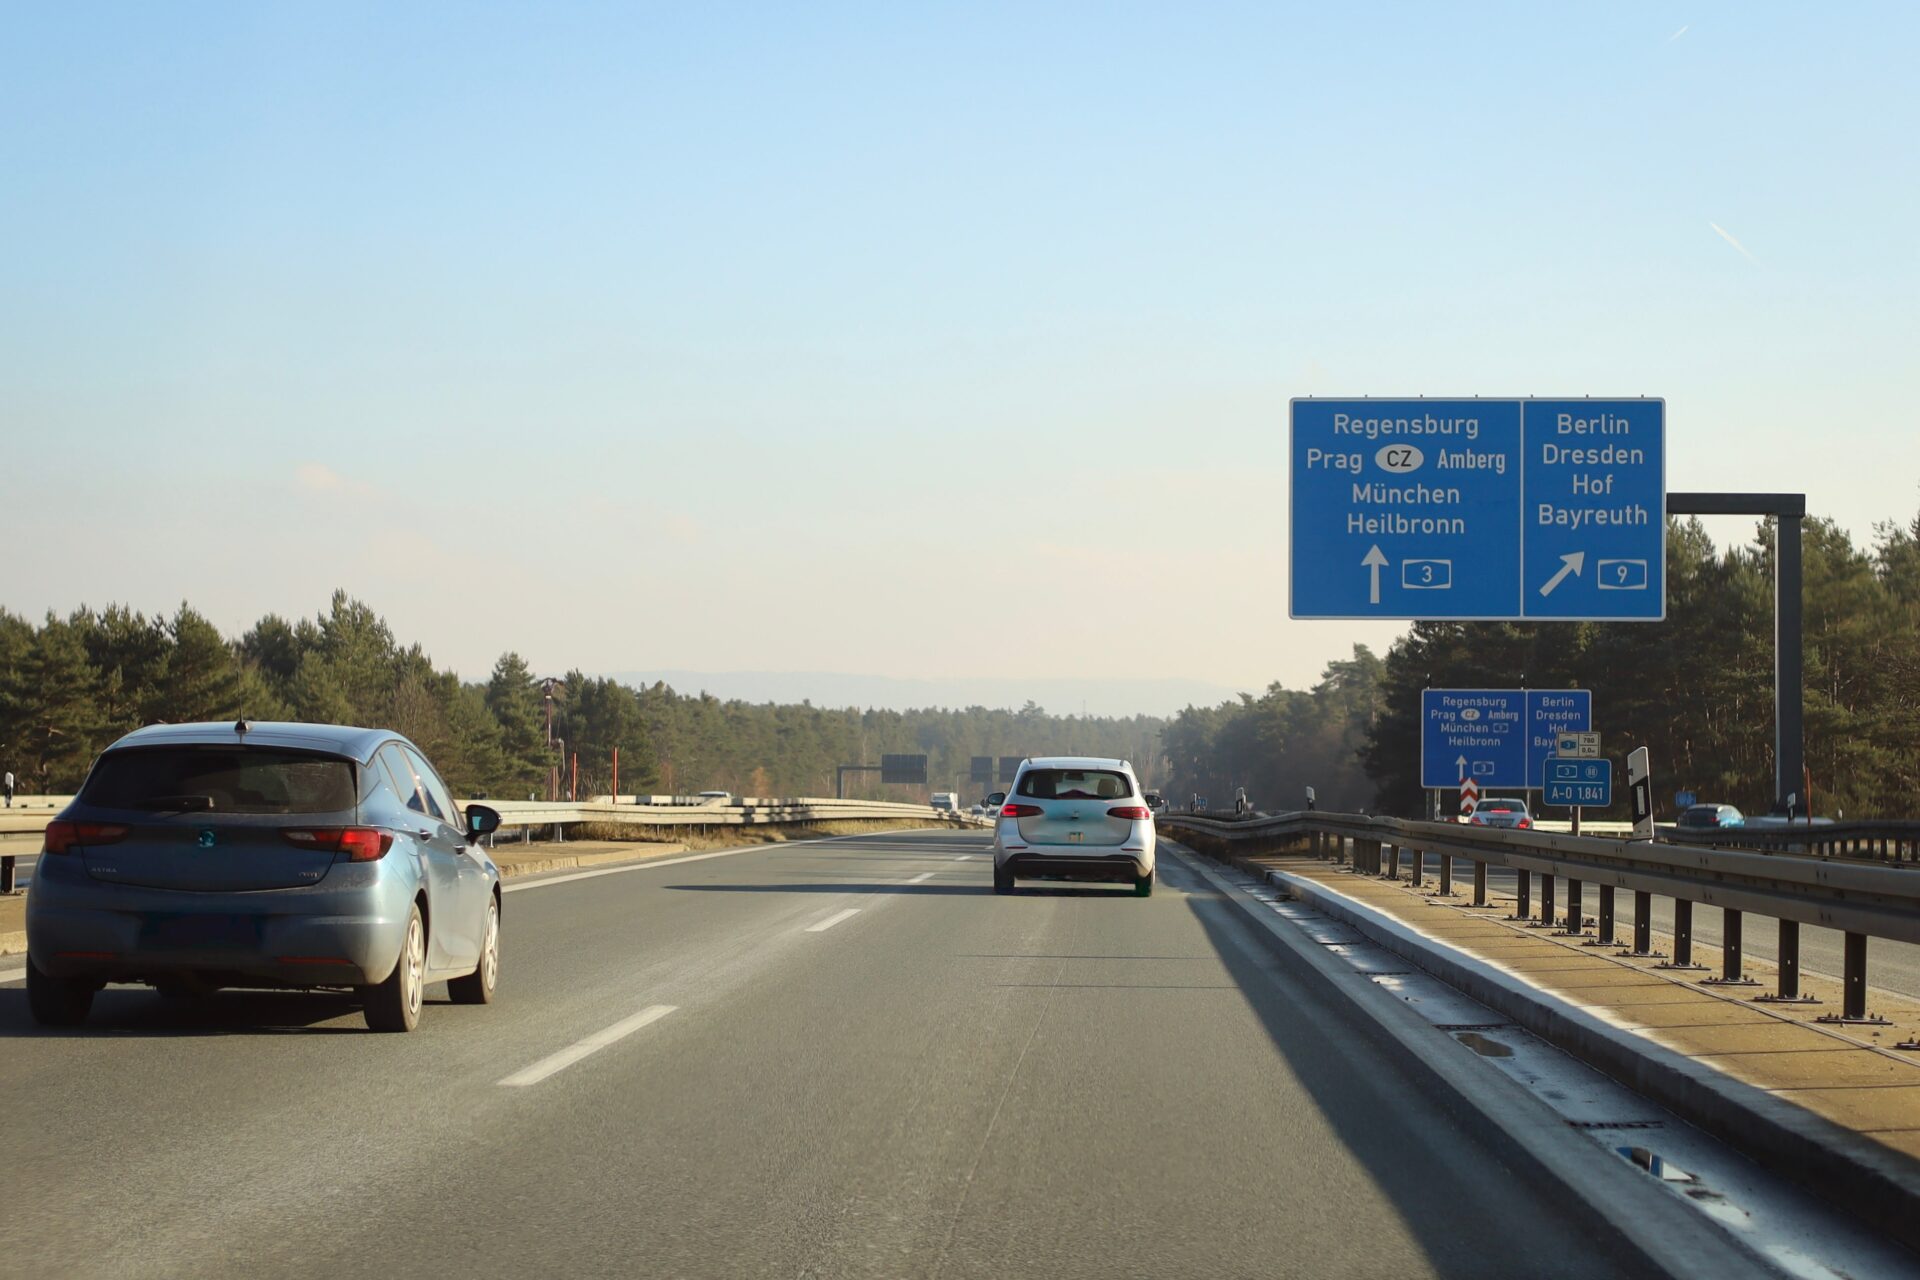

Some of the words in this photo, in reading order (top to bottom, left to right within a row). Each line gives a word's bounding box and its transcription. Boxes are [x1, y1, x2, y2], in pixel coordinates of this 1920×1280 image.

[1333, 414, 1479, 439] Regensburg
[1556, 414, 1629, 434] Berlin
[1307, 448, 1363, 474] Prag
[1386, 450, 1412, 467] CZ
[1437, 448, 1506, 474] Amberg
[1543, 444, 1643, 464] Dresden
[1572, 474, 1613, 494] Hof
[1352, 482, 1460, 504] München
[1347, 513, 1465, 533] Heilbronn
[1538, 504, 1648, 530] Bayreuth
[1421, 566, 1433, 583] 3
[1617, 566, 1628, 583] 9
[1443, 696, 1507, 708] Regensburg
[1542, 697, 1575, 707] Berlin
[1431, 709, 1456, 722] Prag
[1488, 709, 1519, 722] Amberg
[1536, 710, 1581, 720] Dresden
[1440, 722, 1489, 733] München
[1549, 723, 1567, 733] Hof
[1448, 736, 1501, 746] Heilbronn
[1481, 764, 1487, 772] 3
[1564, 768, 1570, 776] 3
